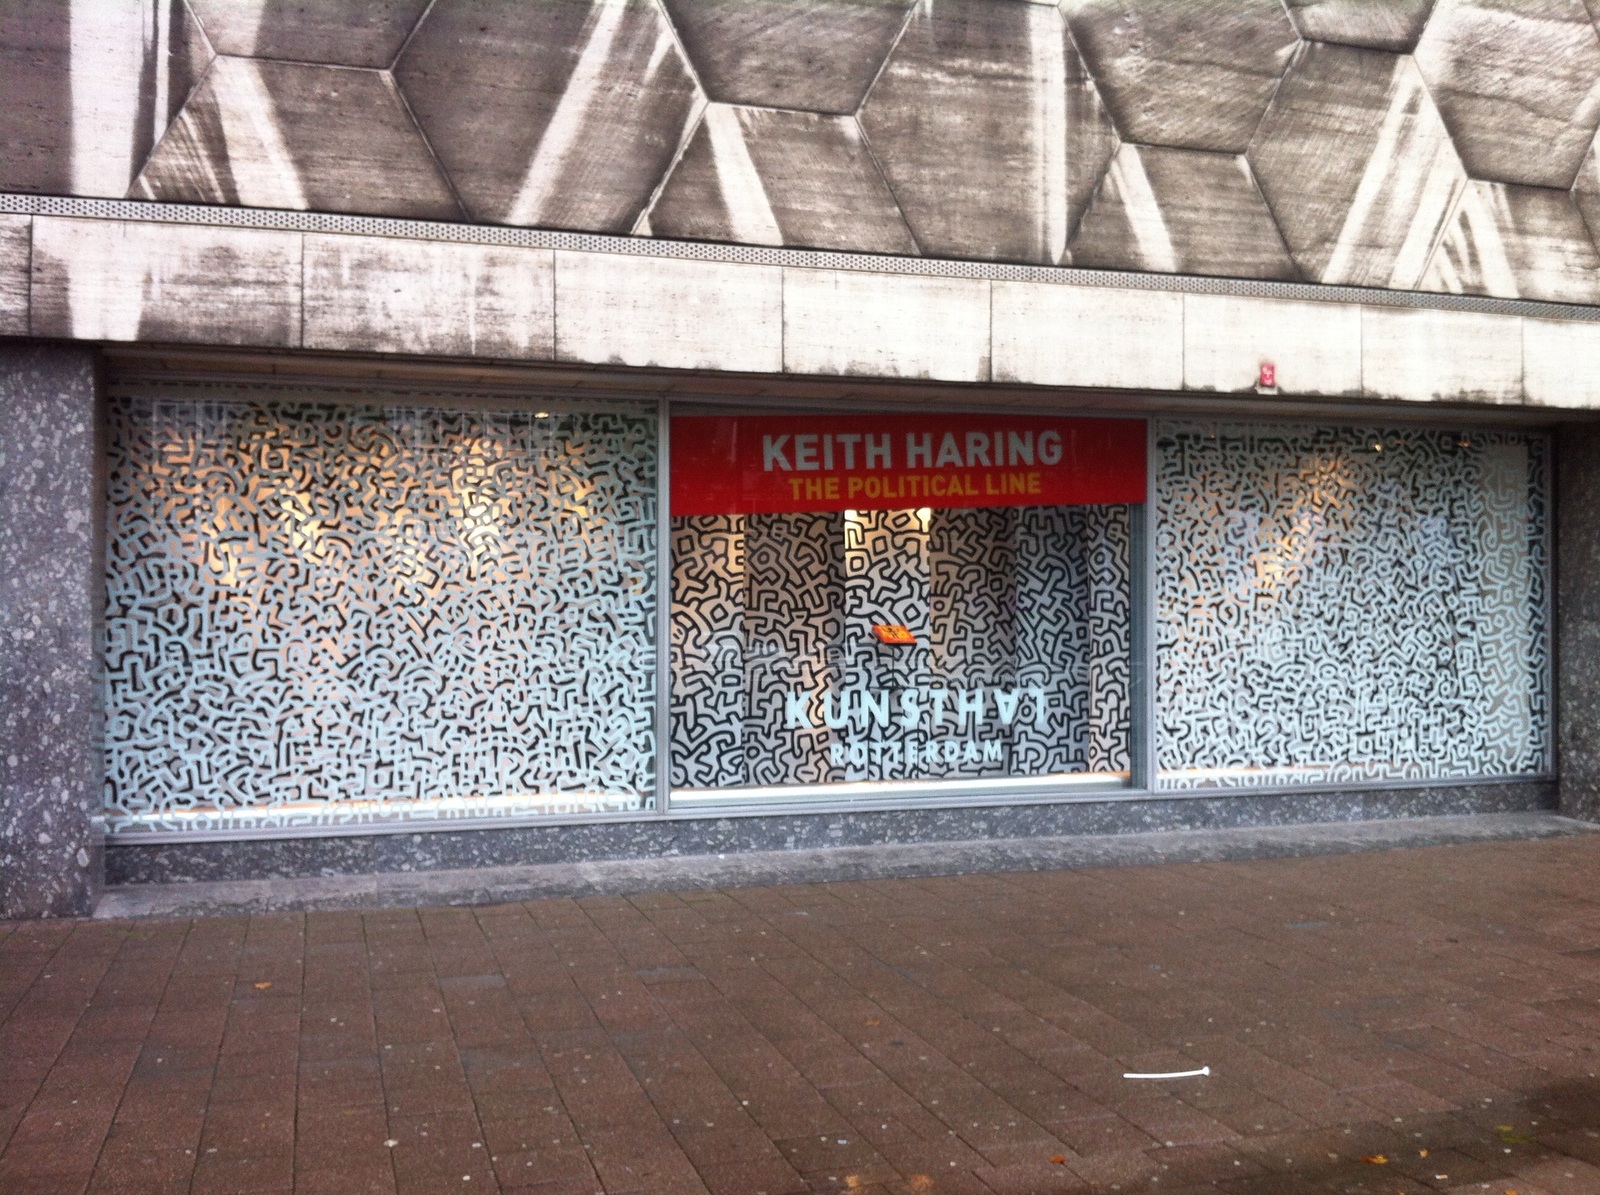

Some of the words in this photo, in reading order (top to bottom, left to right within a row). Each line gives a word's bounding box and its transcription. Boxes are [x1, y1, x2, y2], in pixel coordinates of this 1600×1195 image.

[763, 434, 892, 471] KEITH
[906, 431, 1063, 467] HARING
[789, 478, 840, 499] THE
[848, 475, 977, 499] POLITICAL
[986, 473, 1041, 495] LINE
[830, 740, 1004, 766] ROTTERDAM
